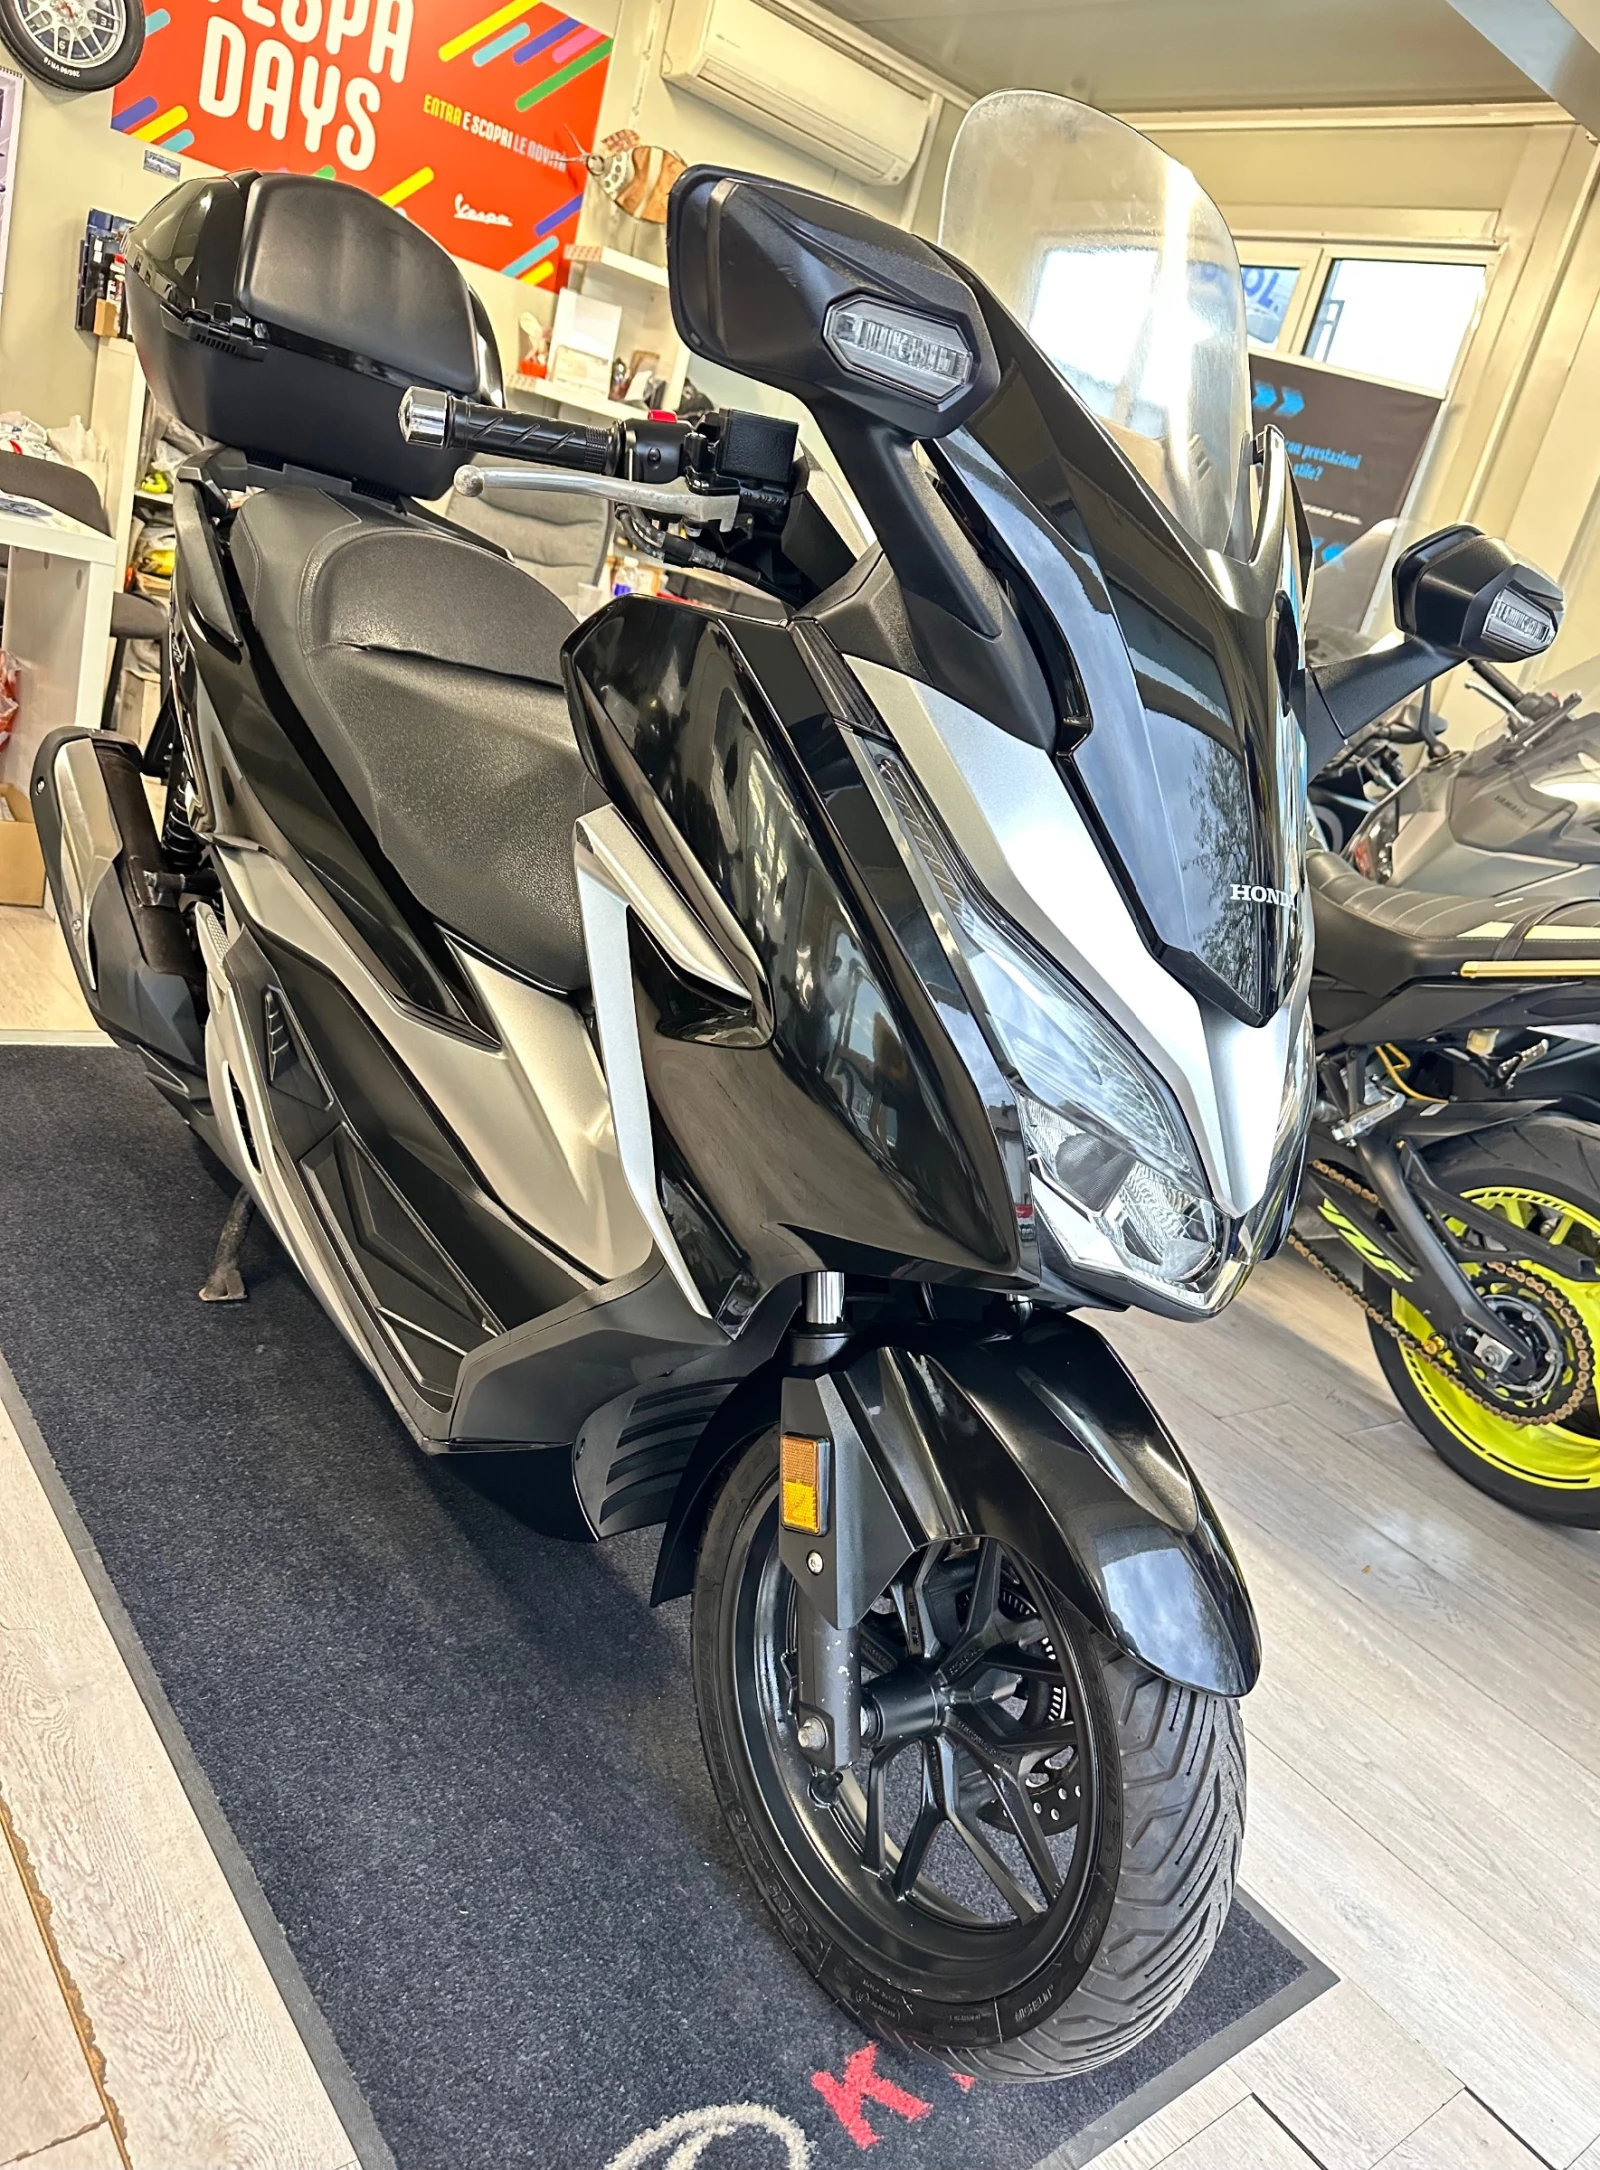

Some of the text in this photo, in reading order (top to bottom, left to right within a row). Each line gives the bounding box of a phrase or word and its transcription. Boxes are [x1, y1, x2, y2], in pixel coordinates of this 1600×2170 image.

[199, 15, 381, 171] DAYS
[423, 94, 462, 126] ENTRA
[462, 111, 472, 131] E
[471, 115, 513, 149] SCOPRI
[513, 134, 527, 155] LE
[453, 193, 513, 227] Vespa
